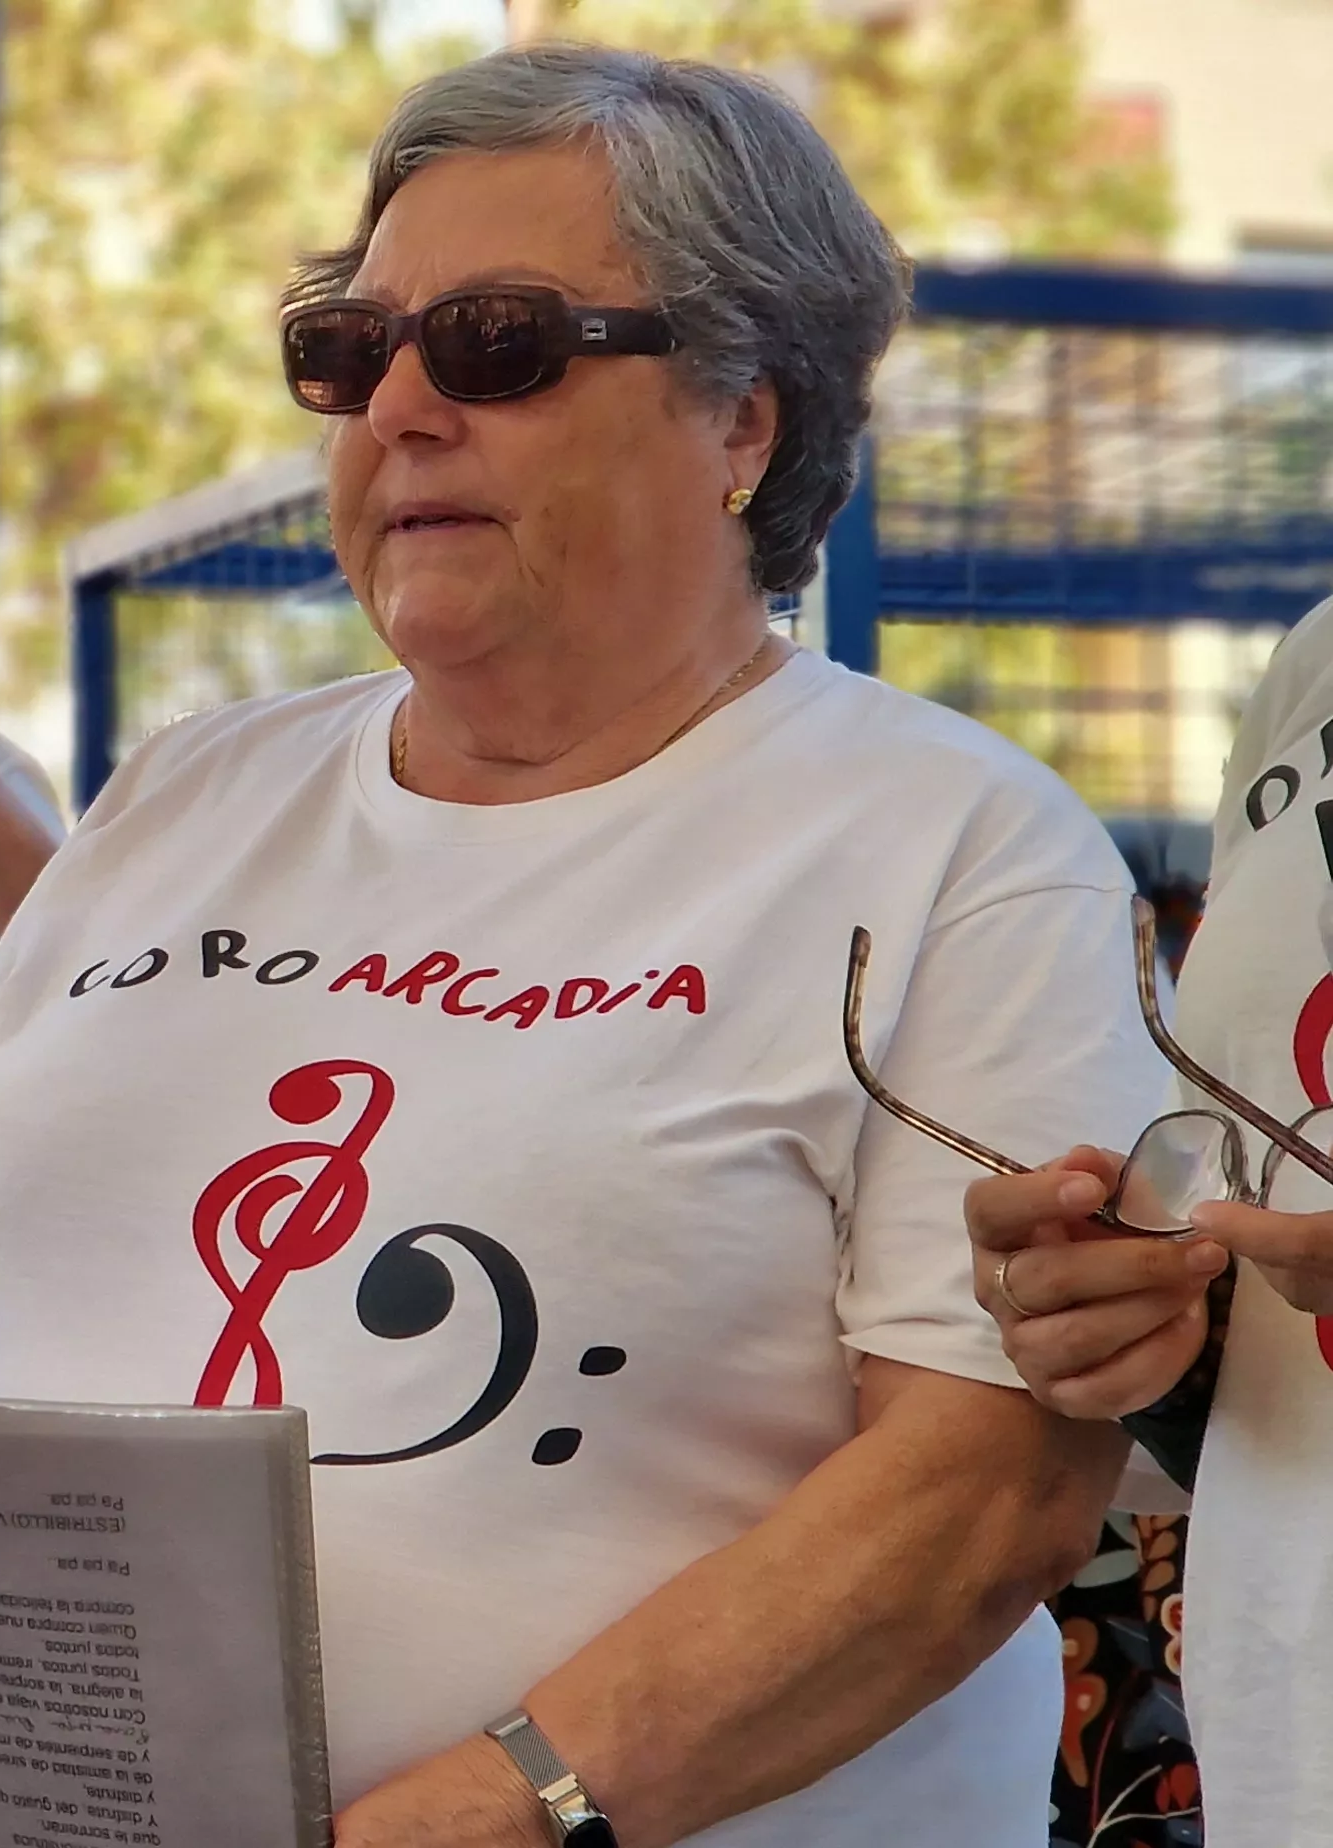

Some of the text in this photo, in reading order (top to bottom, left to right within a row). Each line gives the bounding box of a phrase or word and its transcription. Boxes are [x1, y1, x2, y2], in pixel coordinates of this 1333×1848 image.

[69, 929, 320, 998] CORO
[101, 1494, 124, 1512] Pa
[107, 1559, 130, 1577] Pa
[27, 1617, 85, 1635] compra
[94, 1643, 139, 1660] todos
[92, 1664, 140, 1683] Todos
[48, 1680, 63, 1696] la
[129, 1688, 143, 1702] la
[43, 1701, 109, 1719] nosotros
[113, 1708, 146, 1725] Con
[15, 1736, 33, 1750] de
[117, 1750, 138, 1765] de
[142, 1749, 150, 1763] y
[31, 1759, 49, 1773] de
[115, 1769, 129, 1783] la
[147, 1791, 155, 1804] y
[147, 1814, 158, 1828] Y
[115, 1831, 128, 1844] le
[132, 1833, 161, 1847] que
